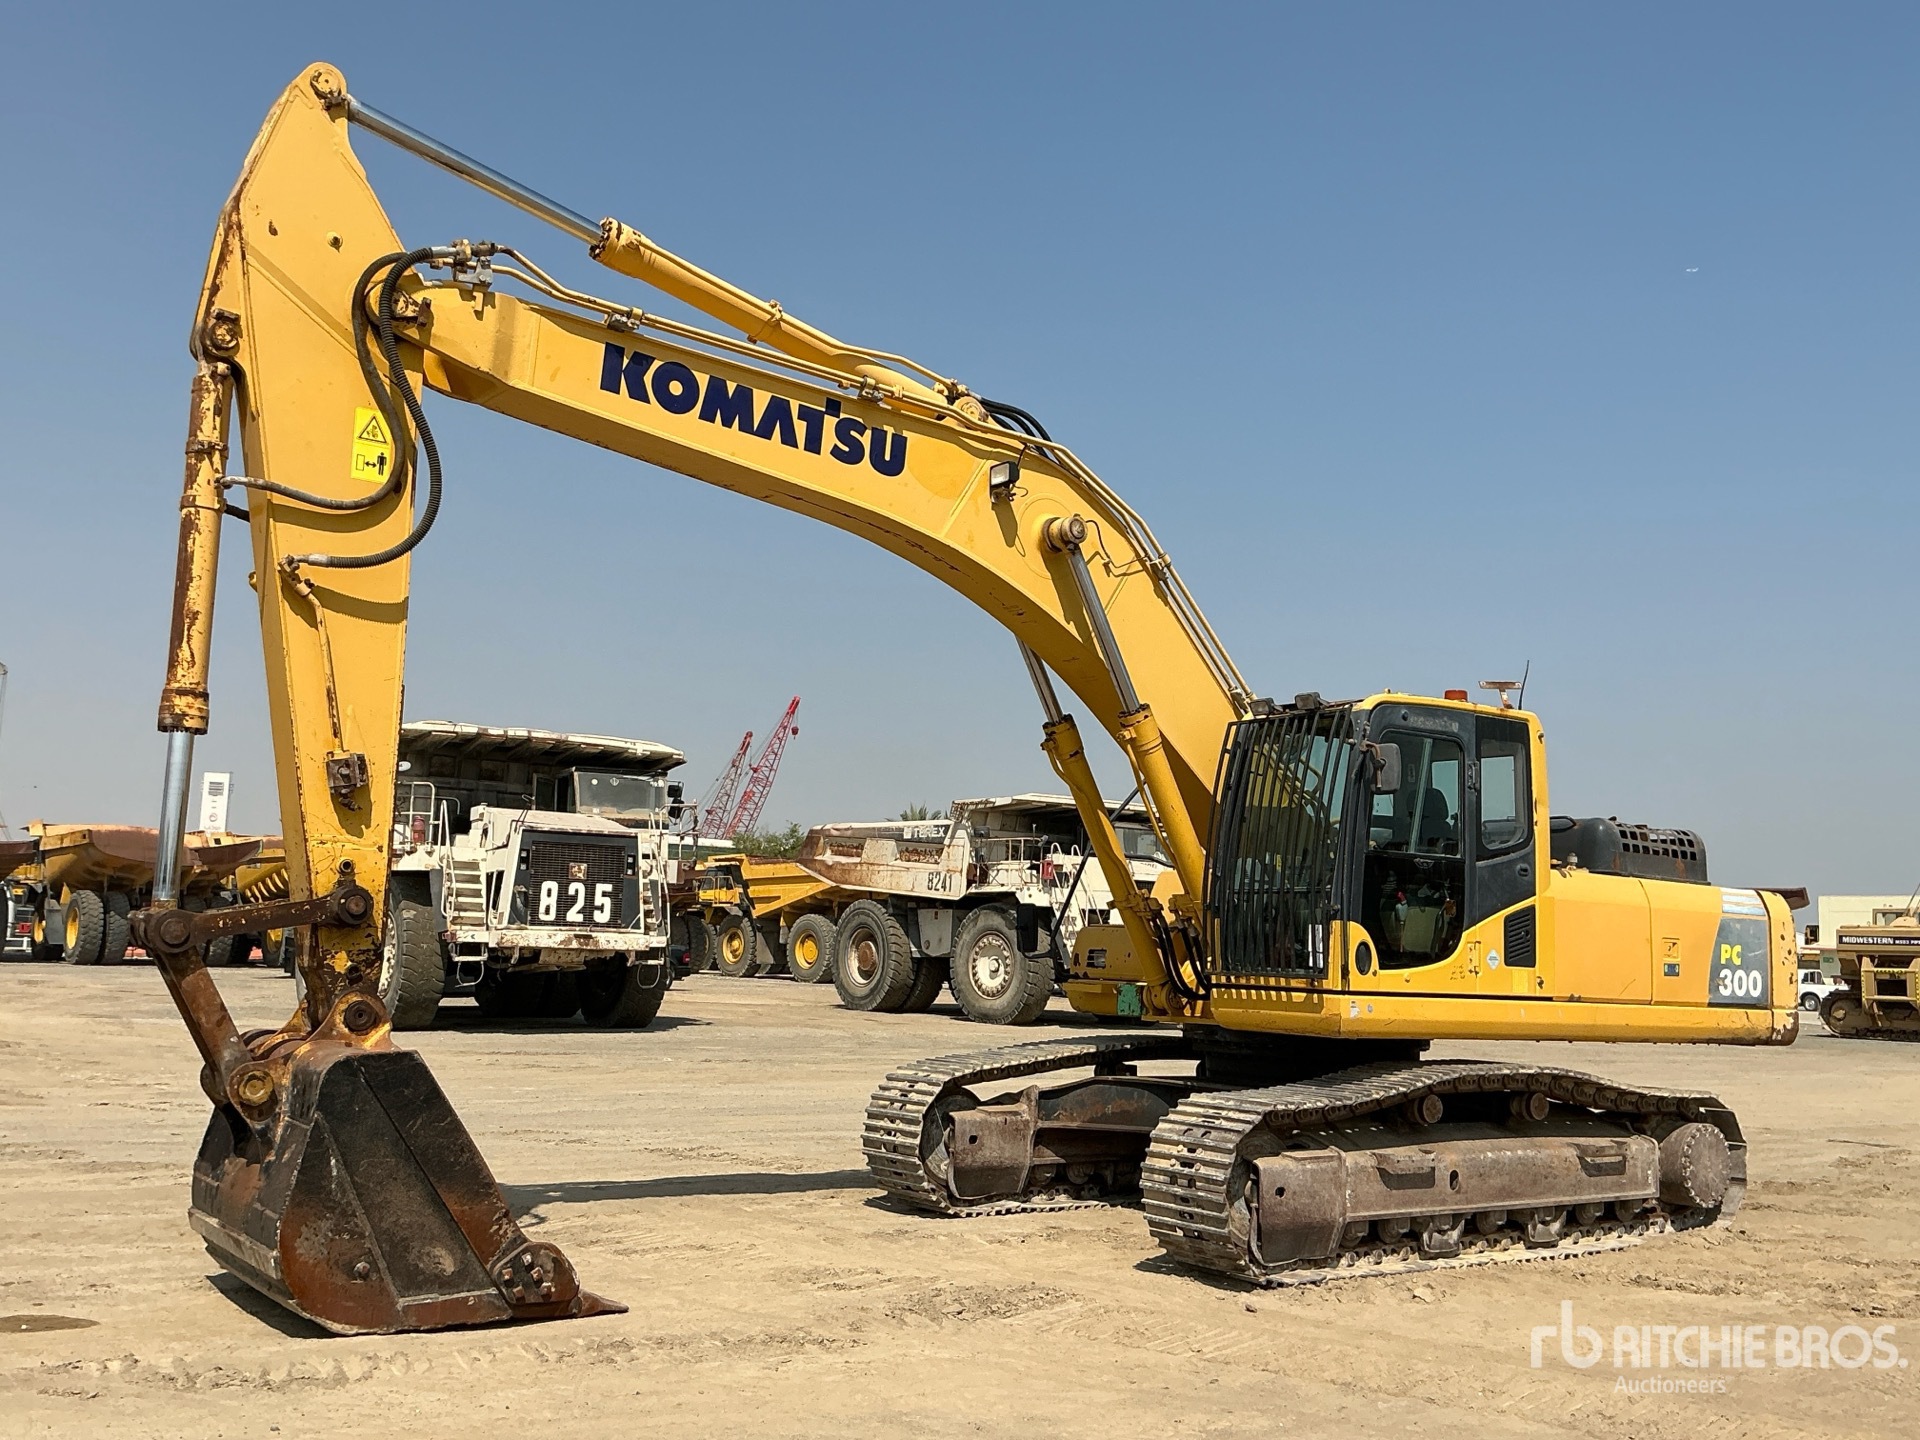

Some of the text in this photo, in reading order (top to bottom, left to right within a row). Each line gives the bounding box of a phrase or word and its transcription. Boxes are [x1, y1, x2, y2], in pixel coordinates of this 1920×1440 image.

[600, 341, 908, 477] KOMATSU
[914, 826, 946, 839] TEREX
[927, 872, 953, 893] 8241
[538, 880, 613, 924] 825
[1842, 936, 1894, 945] MIDWESTERN
[1720, 943, 1742, 966] PC
[1718, 968, 1763, 998] 300
